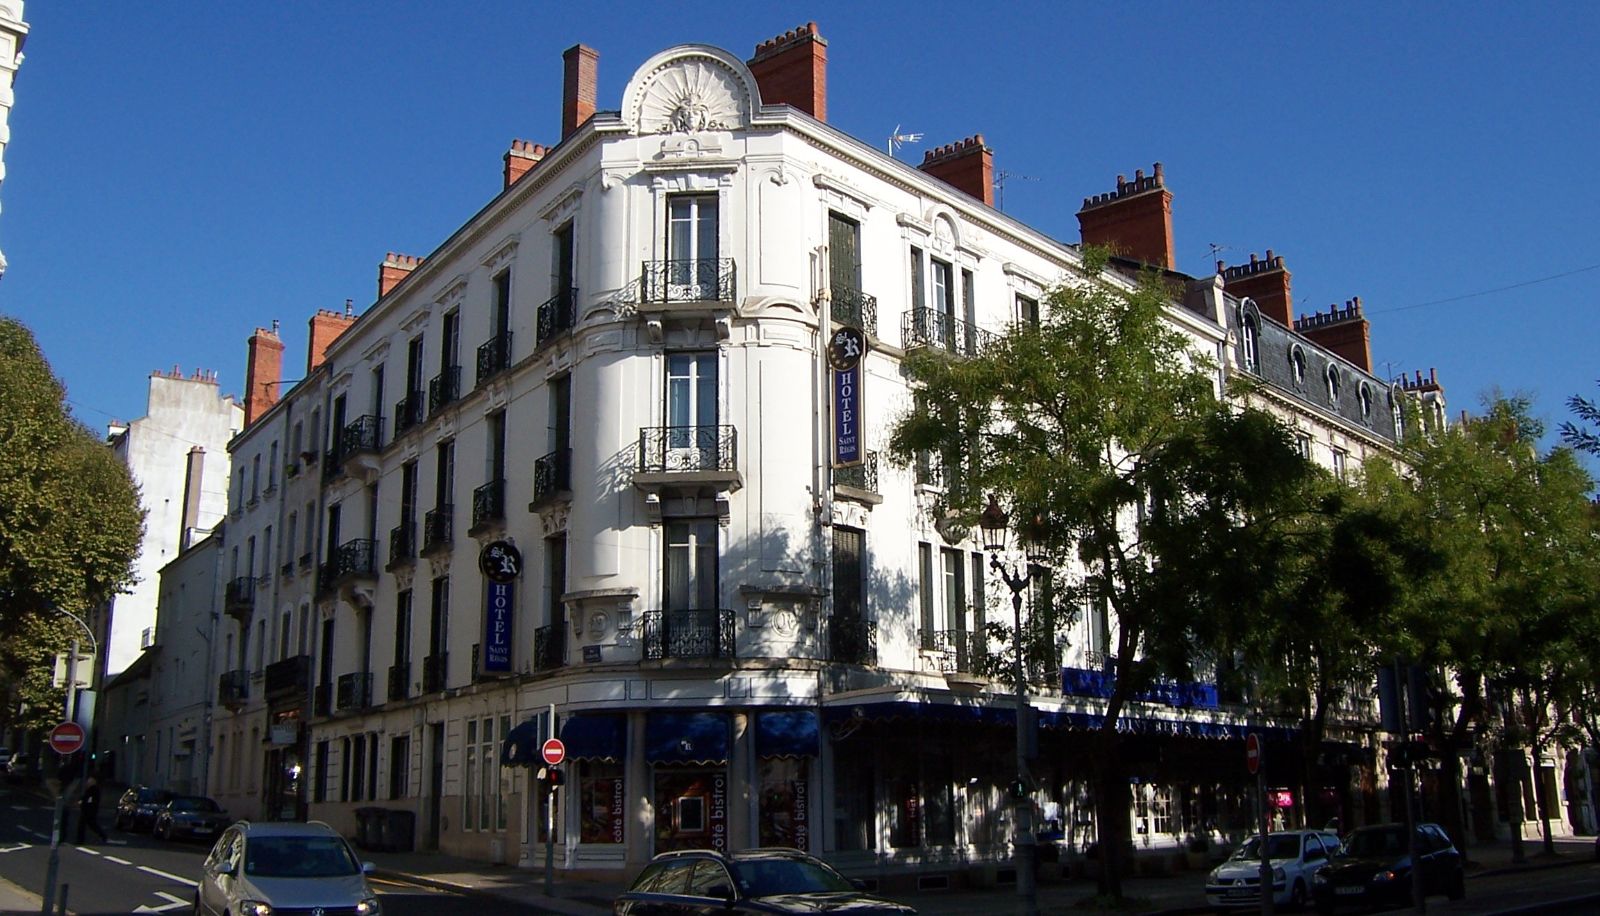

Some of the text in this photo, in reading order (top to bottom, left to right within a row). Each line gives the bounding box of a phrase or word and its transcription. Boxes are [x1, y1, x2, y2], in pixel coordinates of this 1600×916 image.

[841, 373, 852, 435] HOTEL
[495, 585, 507, 645] HOTEL
[611, 779, 622, 815] bistrot
[710, 774, 724, 819] bistrot
